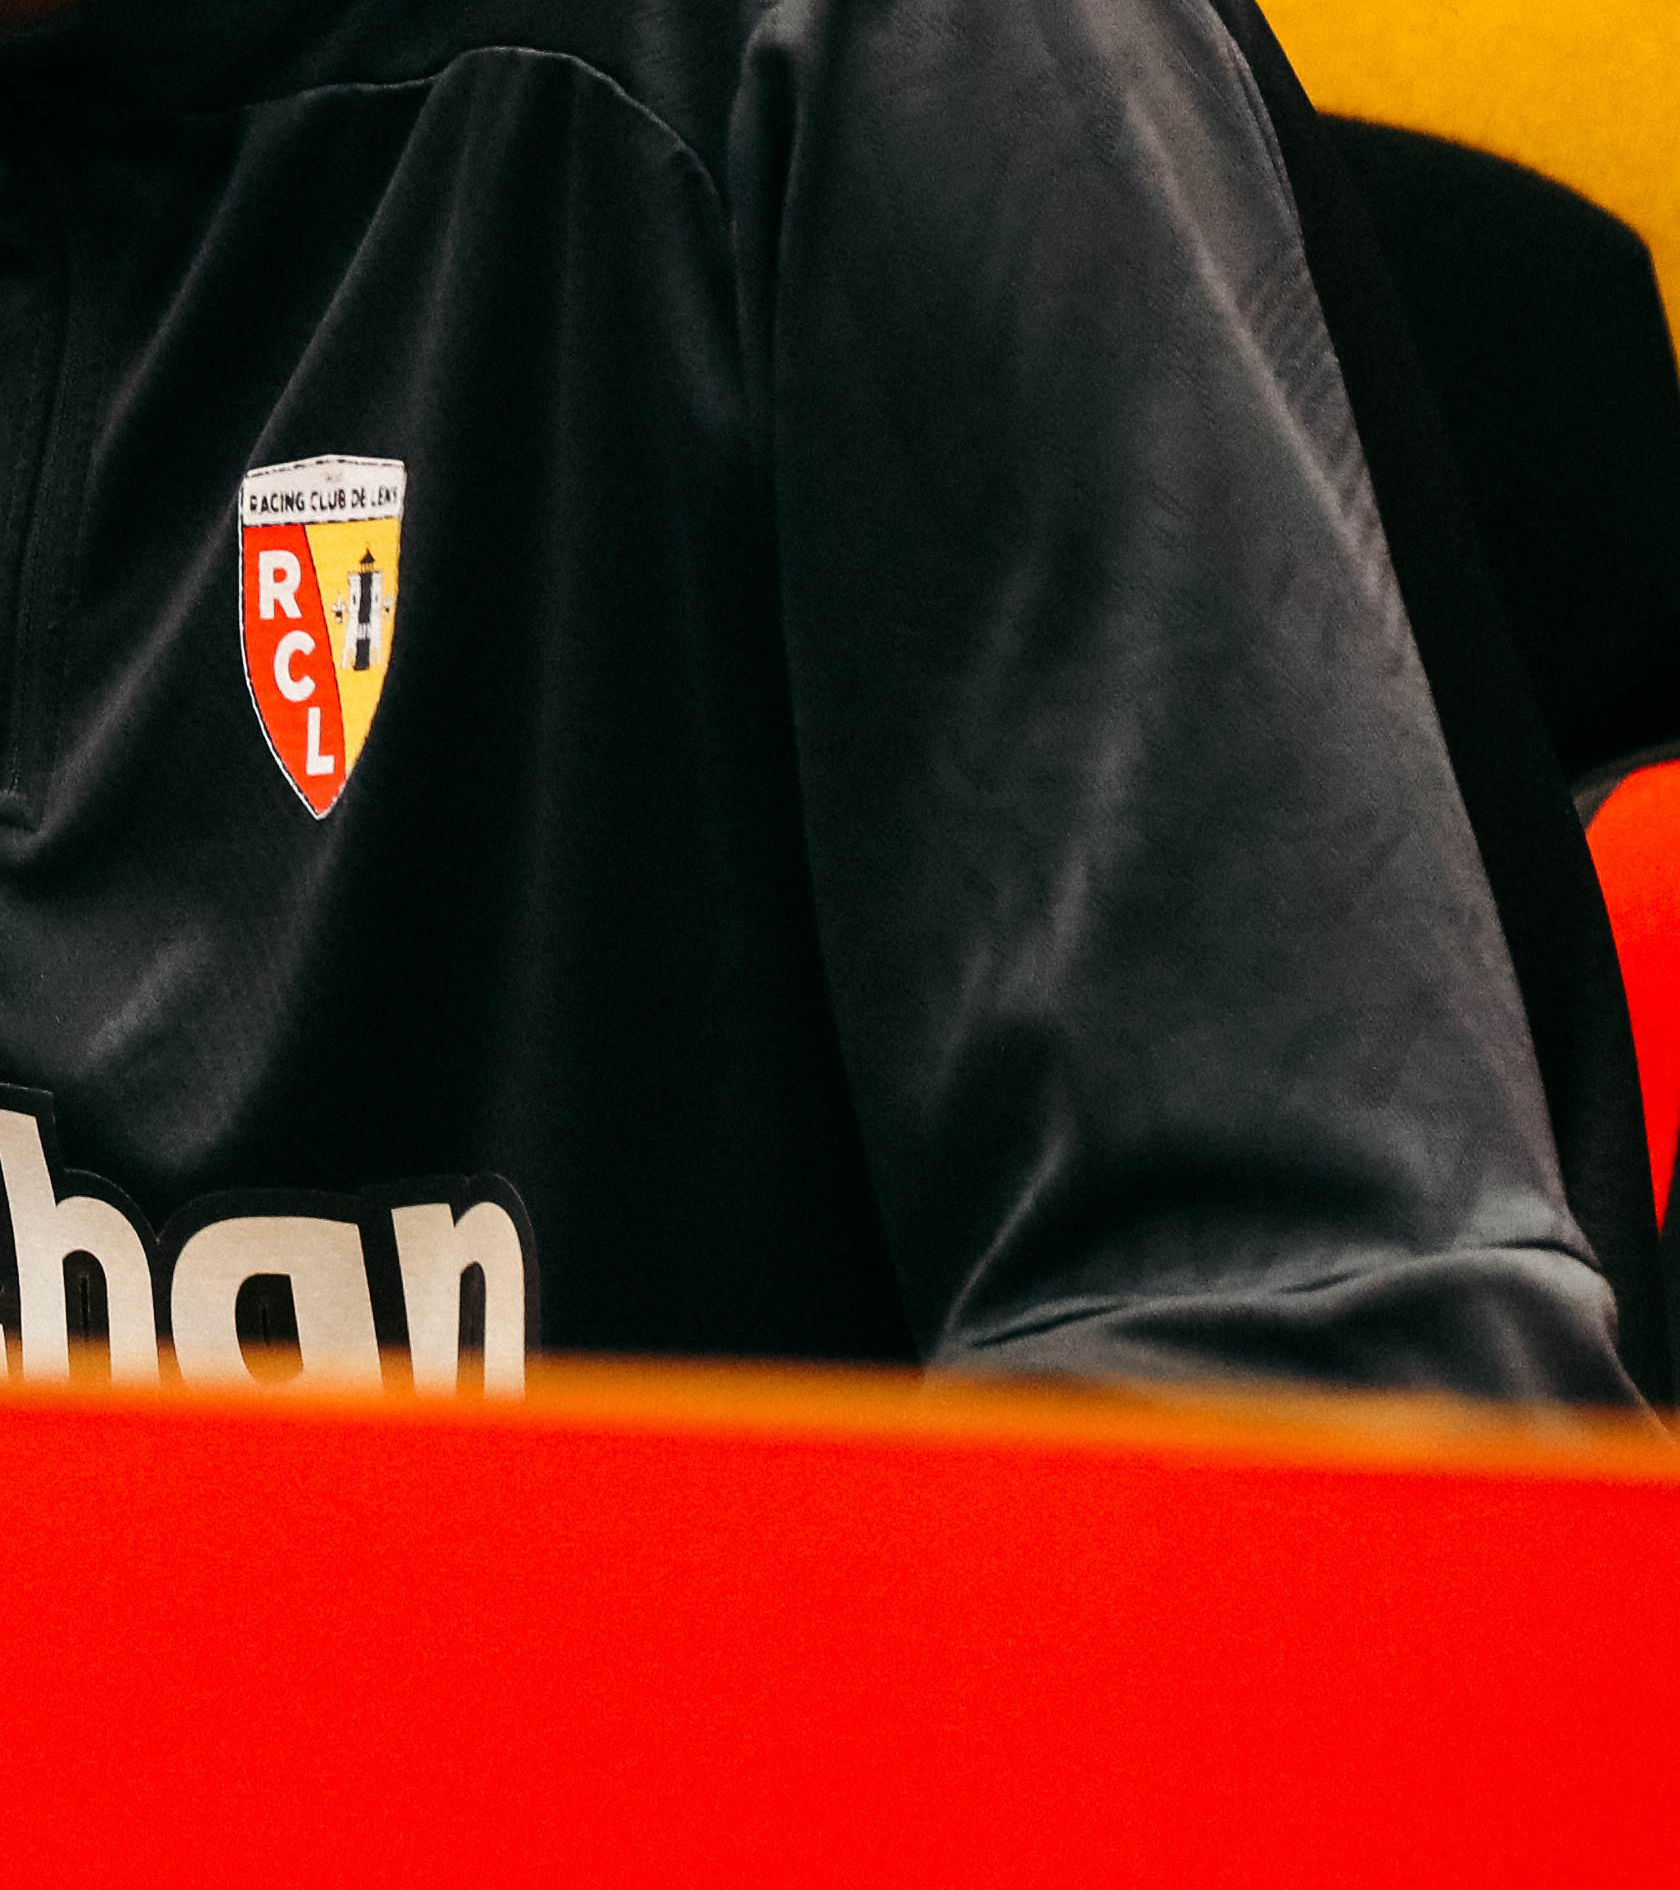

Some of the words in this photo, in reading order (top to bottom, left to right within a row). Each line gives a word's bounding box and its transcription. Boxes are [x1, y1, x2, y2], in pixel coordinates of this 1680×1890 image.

[249, 490, 306, 514] RACING
[310, 488, 347, 512] CLUB
[351, 486, 367, 509] DE
